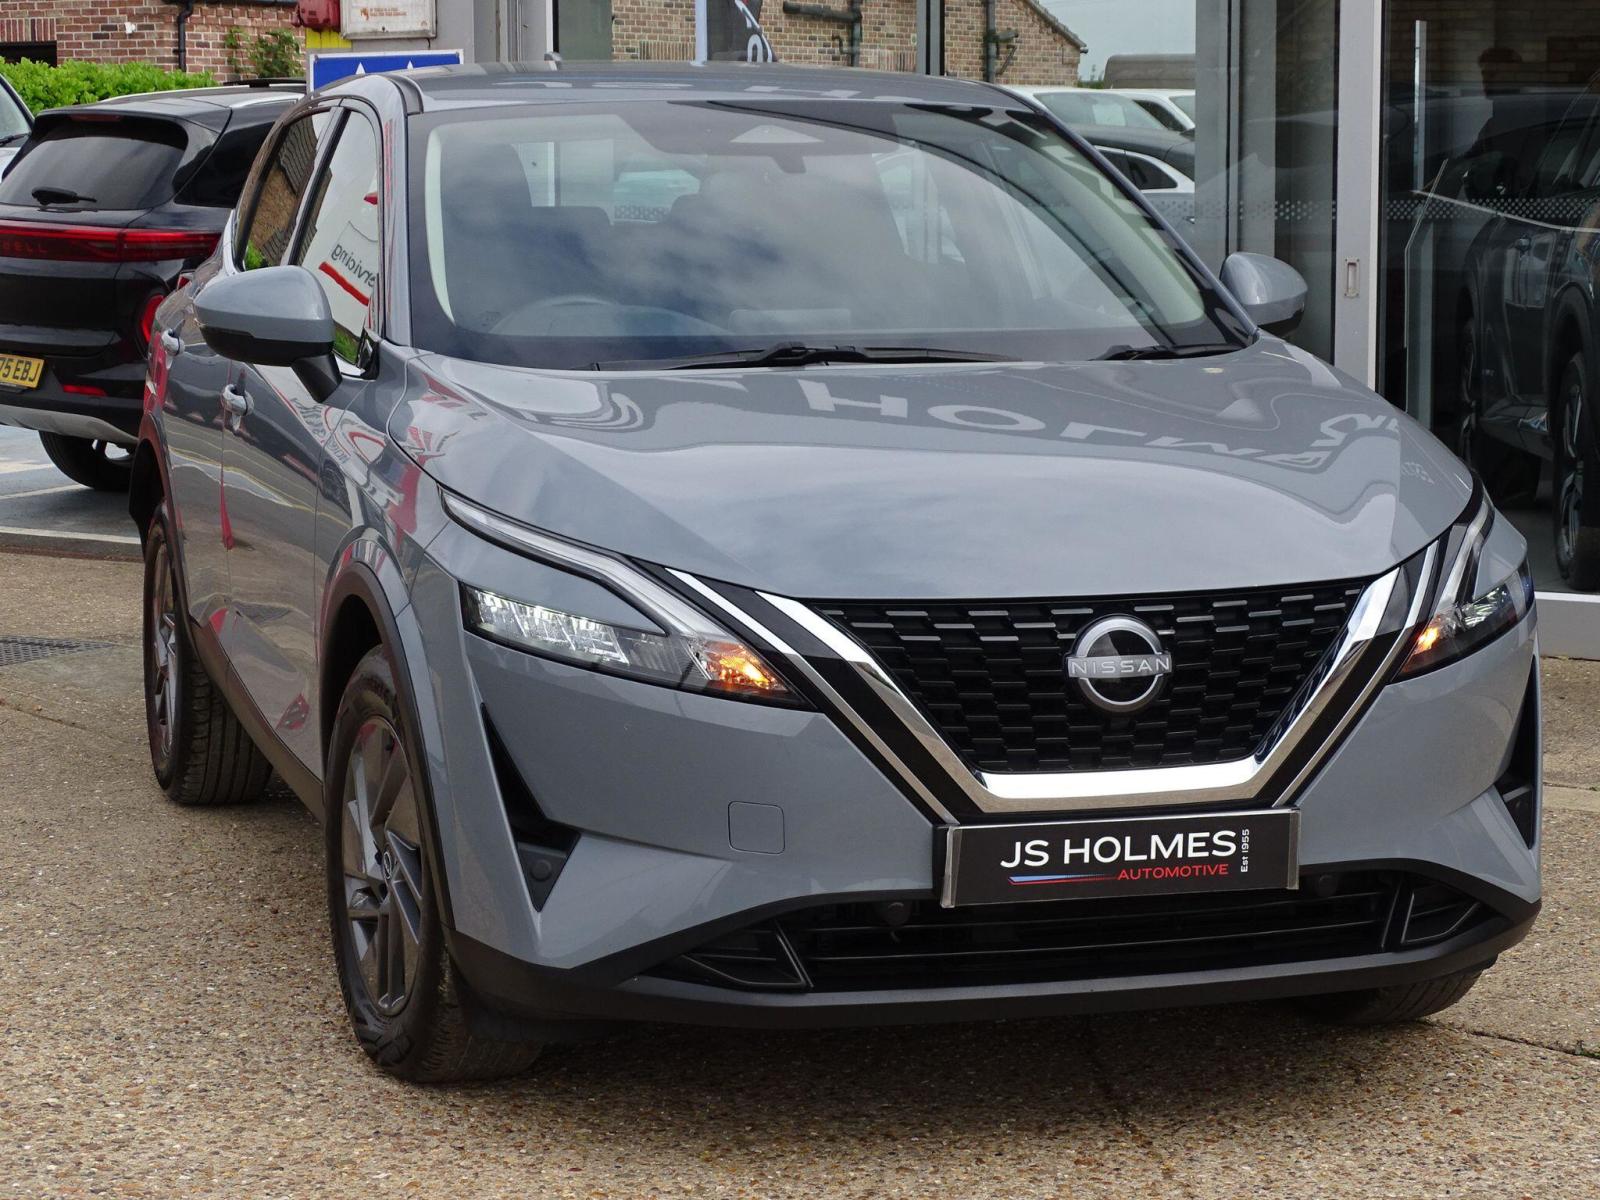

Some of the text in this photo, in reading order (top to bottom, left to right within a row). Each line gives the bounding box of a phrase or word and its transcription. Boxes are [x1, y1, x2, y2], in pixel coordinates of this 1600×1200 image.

[12, 359, 41, 382] EBJ
[1070, 657, 1170, 675] NISSAN
[1000, 829, 1237, 868] JS HOLMES
[1240, 828, 1250, 873] Est 1955
[1117, 863, 1229, 881] AUTOMOTIVE
